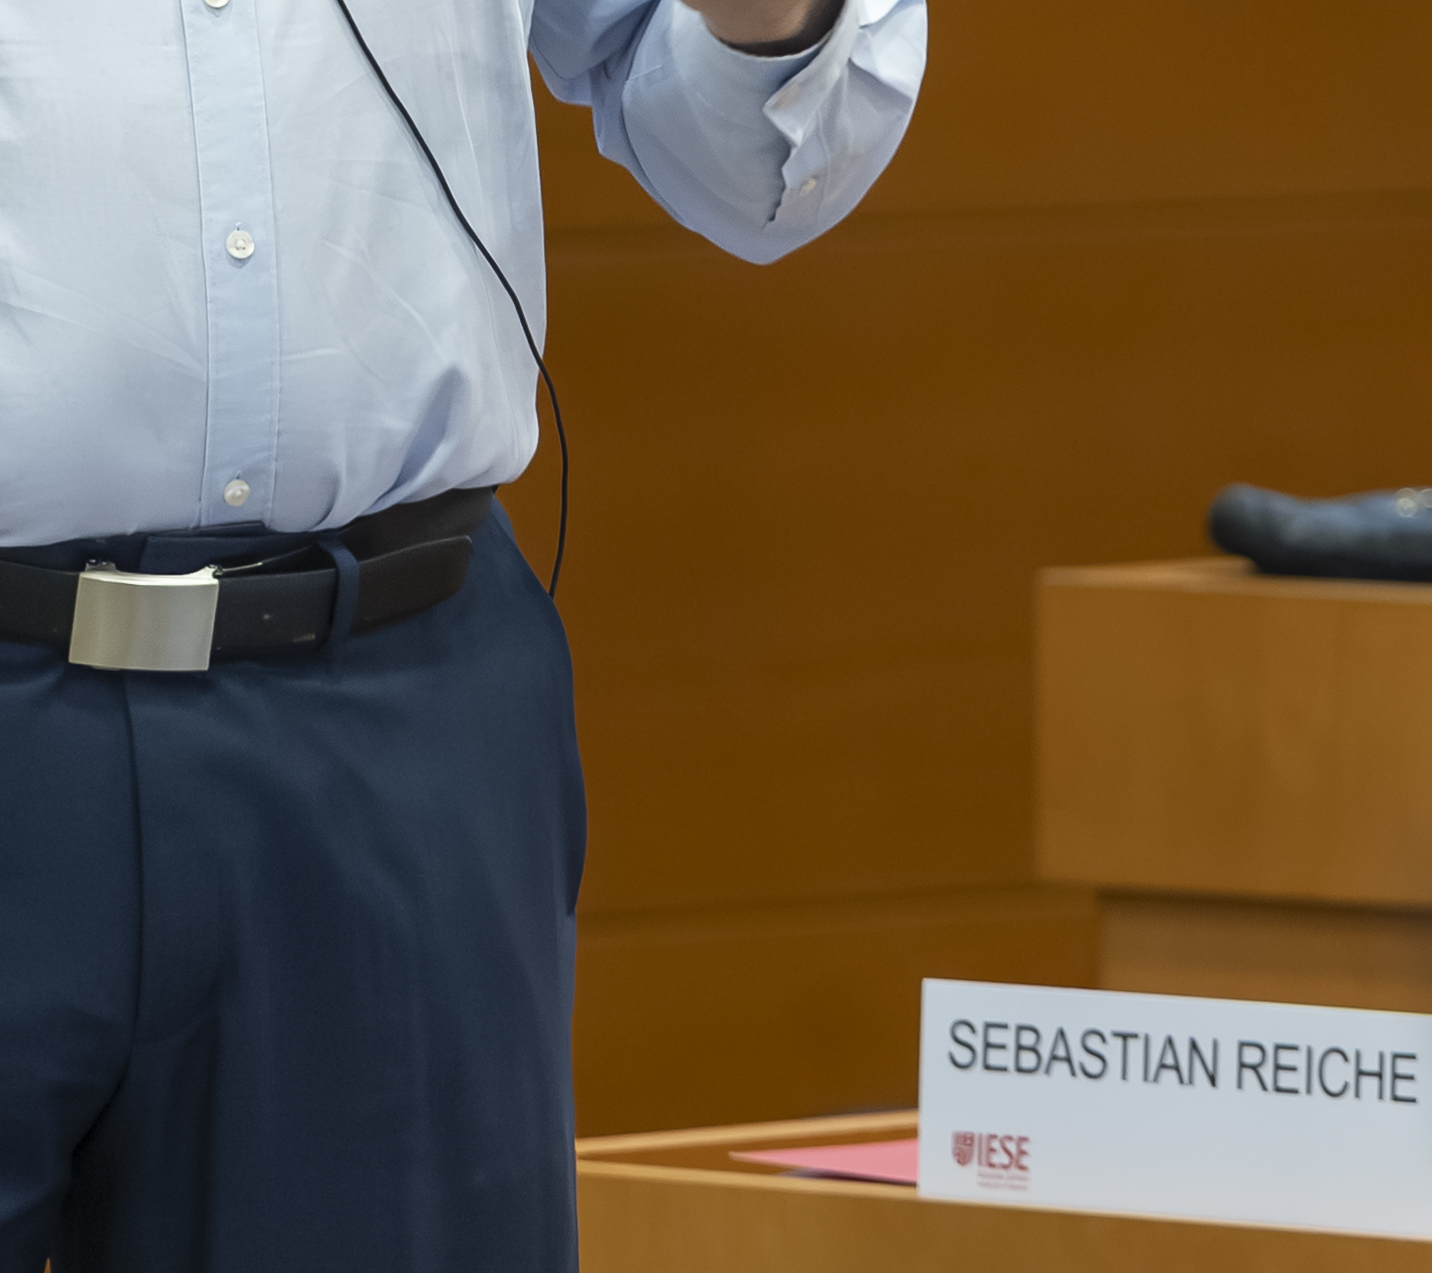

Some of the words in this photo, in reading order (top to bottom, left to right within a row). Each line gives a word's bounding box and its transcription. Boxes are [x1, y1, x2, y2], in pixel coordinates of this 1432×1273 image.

[948, 1019, 1219, 1088] SEBASTIAN
[1236, 1041, 1418, 1104] REICHE
[977, 1133, 1030, 1171] IESE
